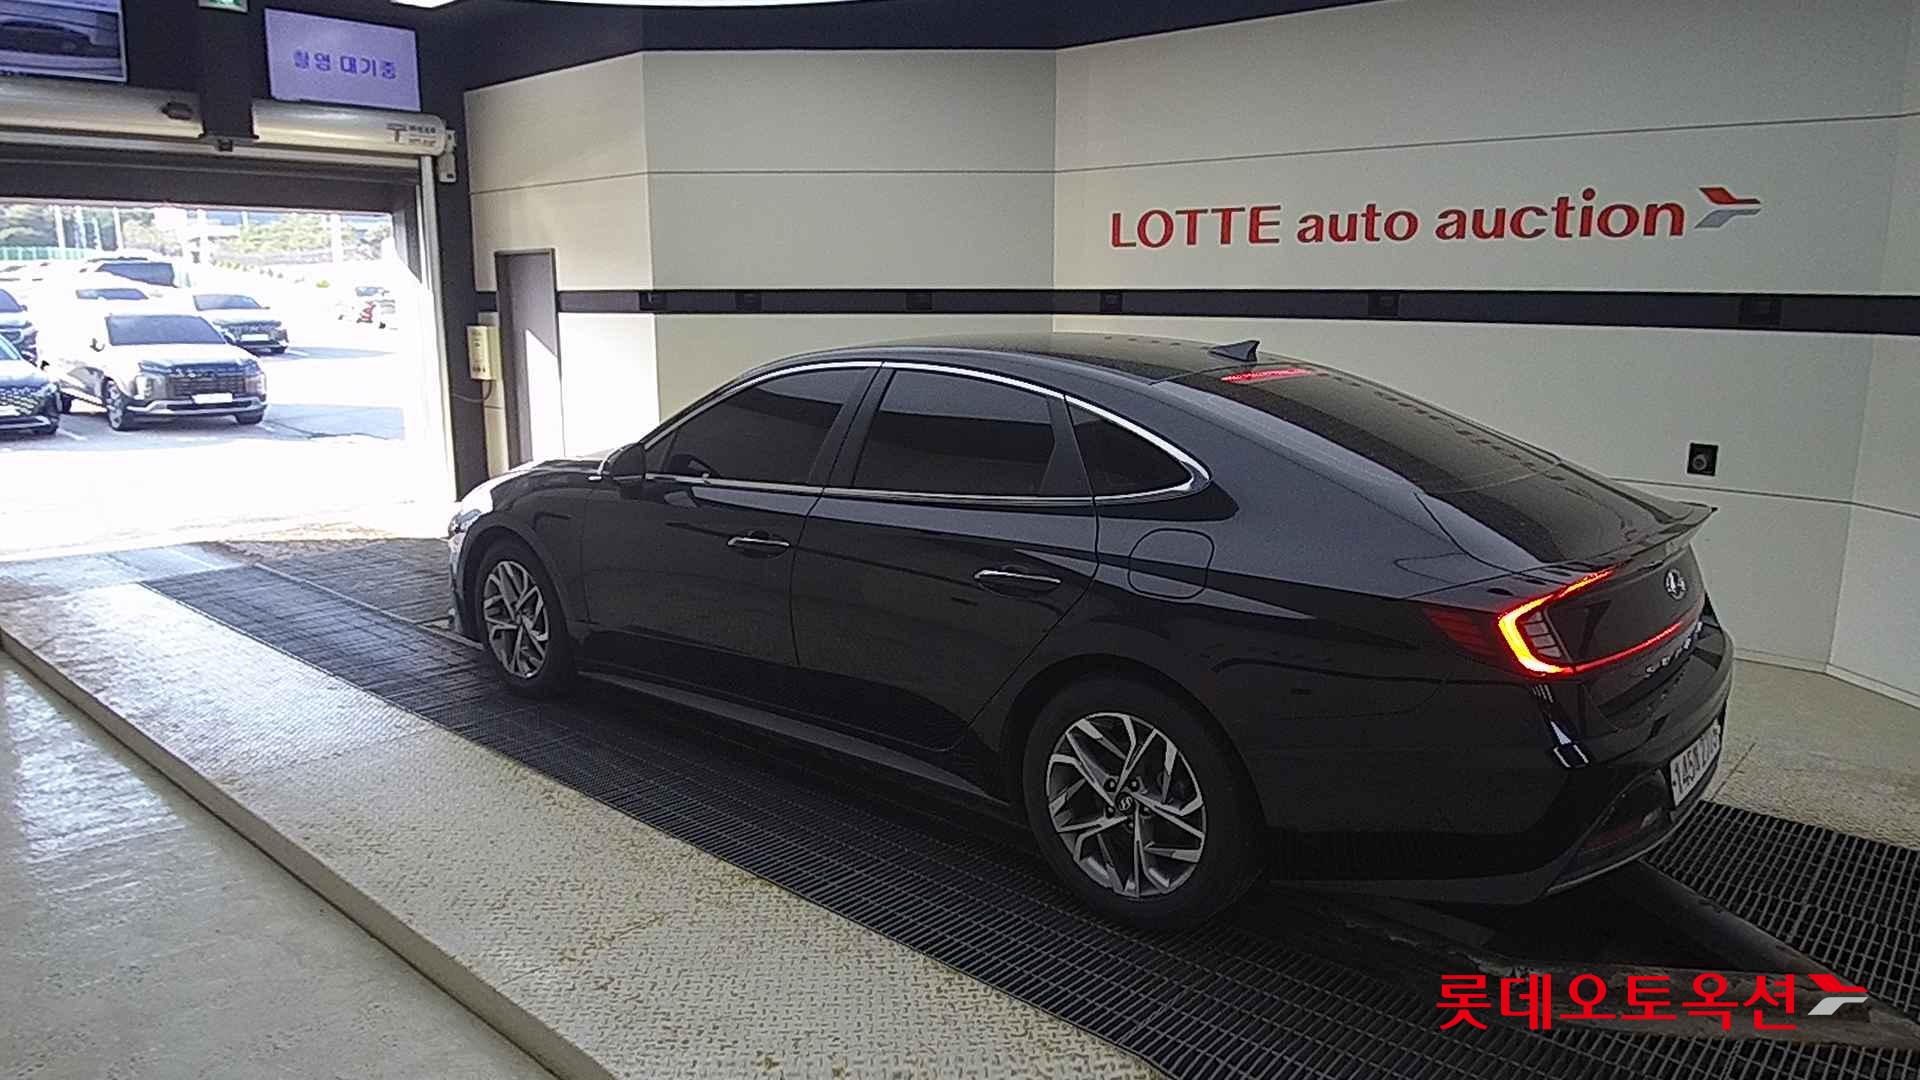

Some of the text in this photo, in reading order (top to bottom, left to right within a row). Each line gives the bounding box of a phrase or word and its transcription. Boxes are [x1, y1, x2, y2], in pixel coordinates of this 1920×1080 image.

[1111, 187, 1685, 248] LOTTE auto auction
